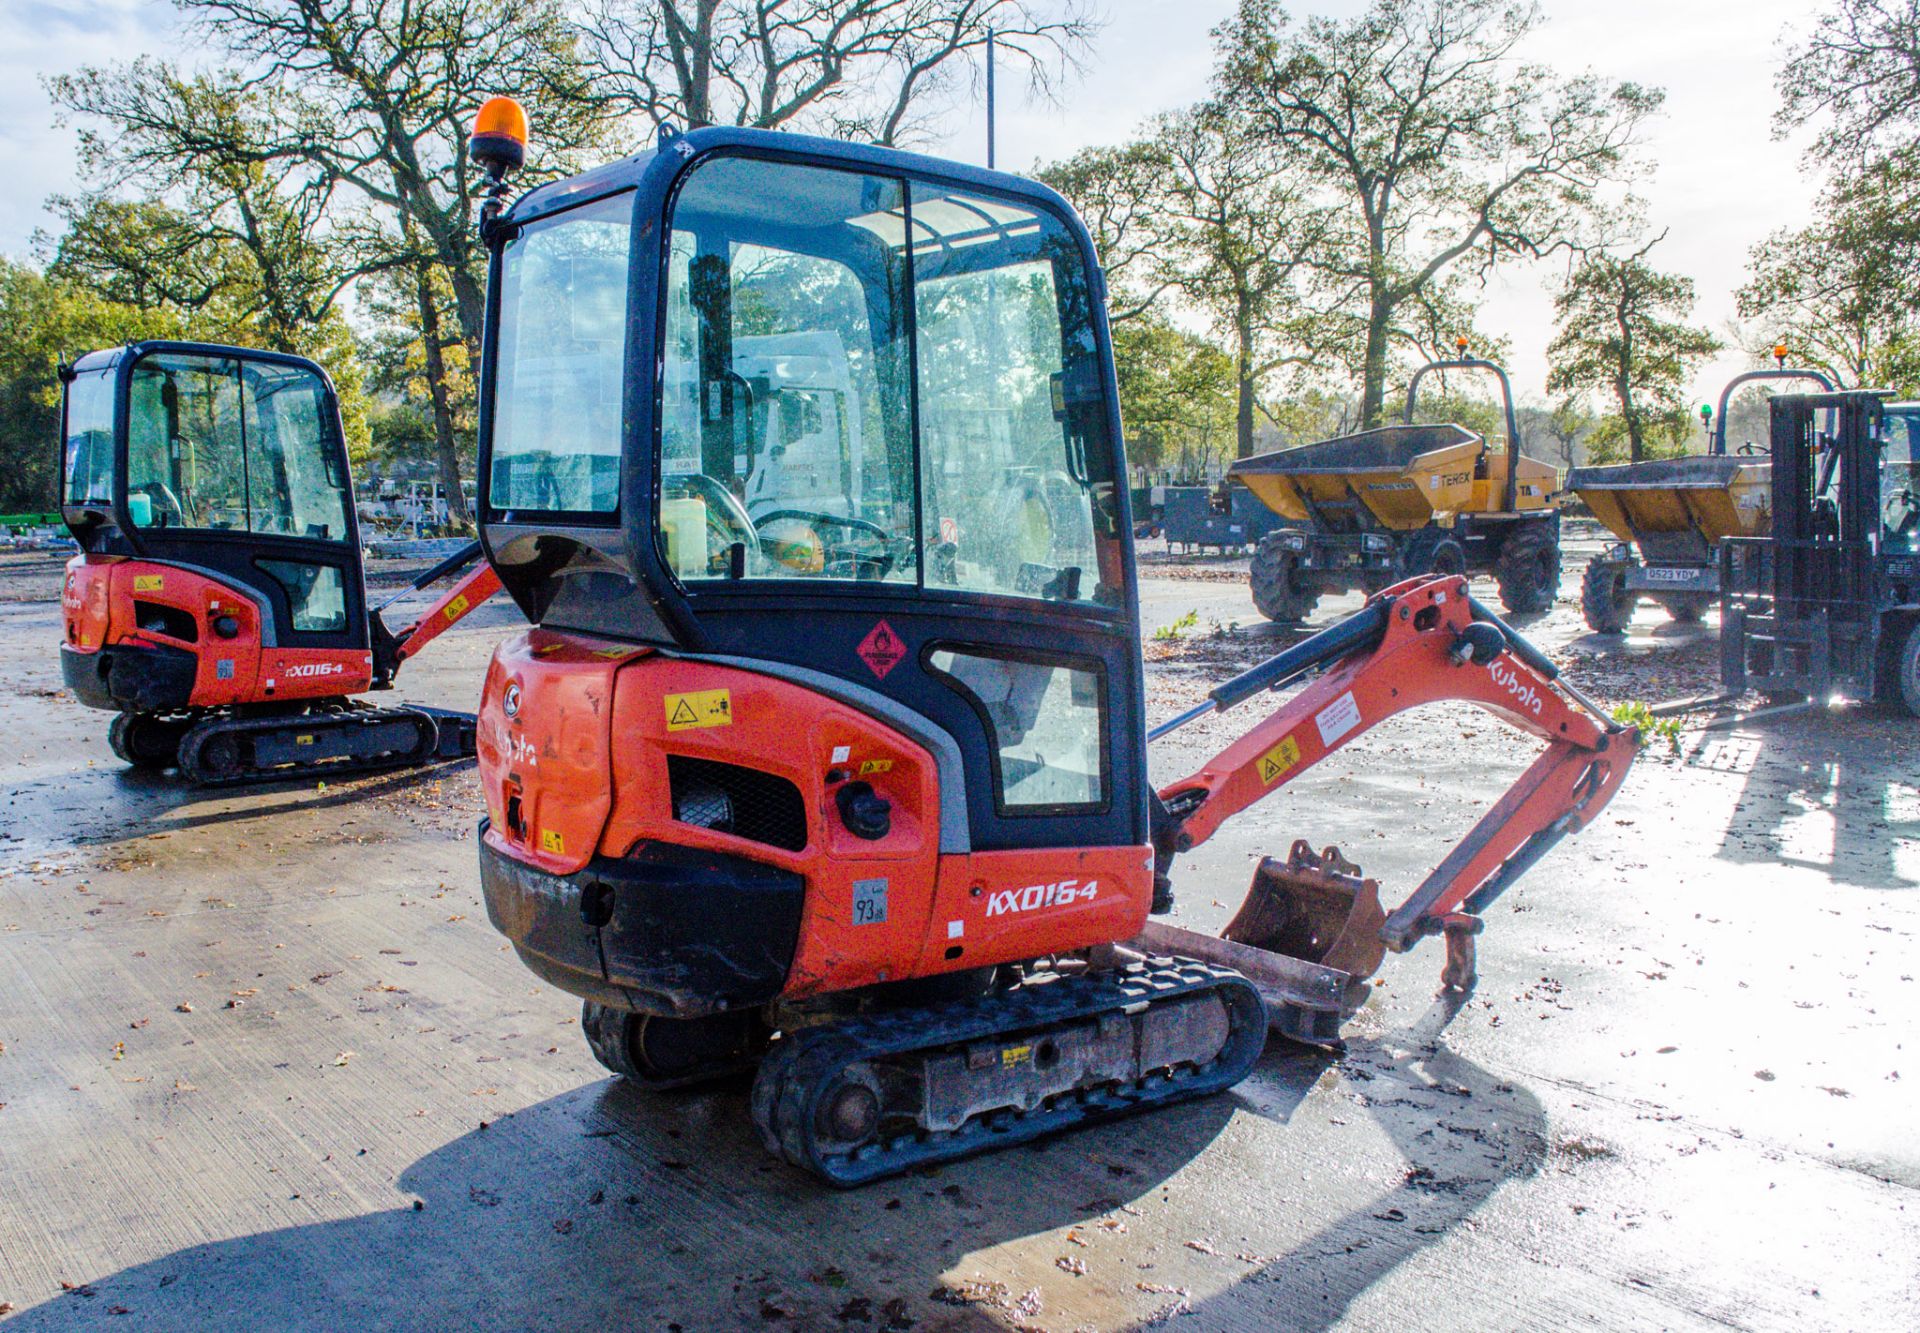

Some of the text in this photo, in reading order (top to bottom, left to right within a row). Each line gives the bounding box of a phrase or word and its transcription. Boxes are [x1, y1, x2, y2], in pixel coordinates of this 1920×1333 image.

[1441, 472, 1471, 488] TEREX
[1486, 660, 1542, 716] Kubota
[856, 898, 874, 922] 93
[985, 879, 1098, 917] KX016-4
